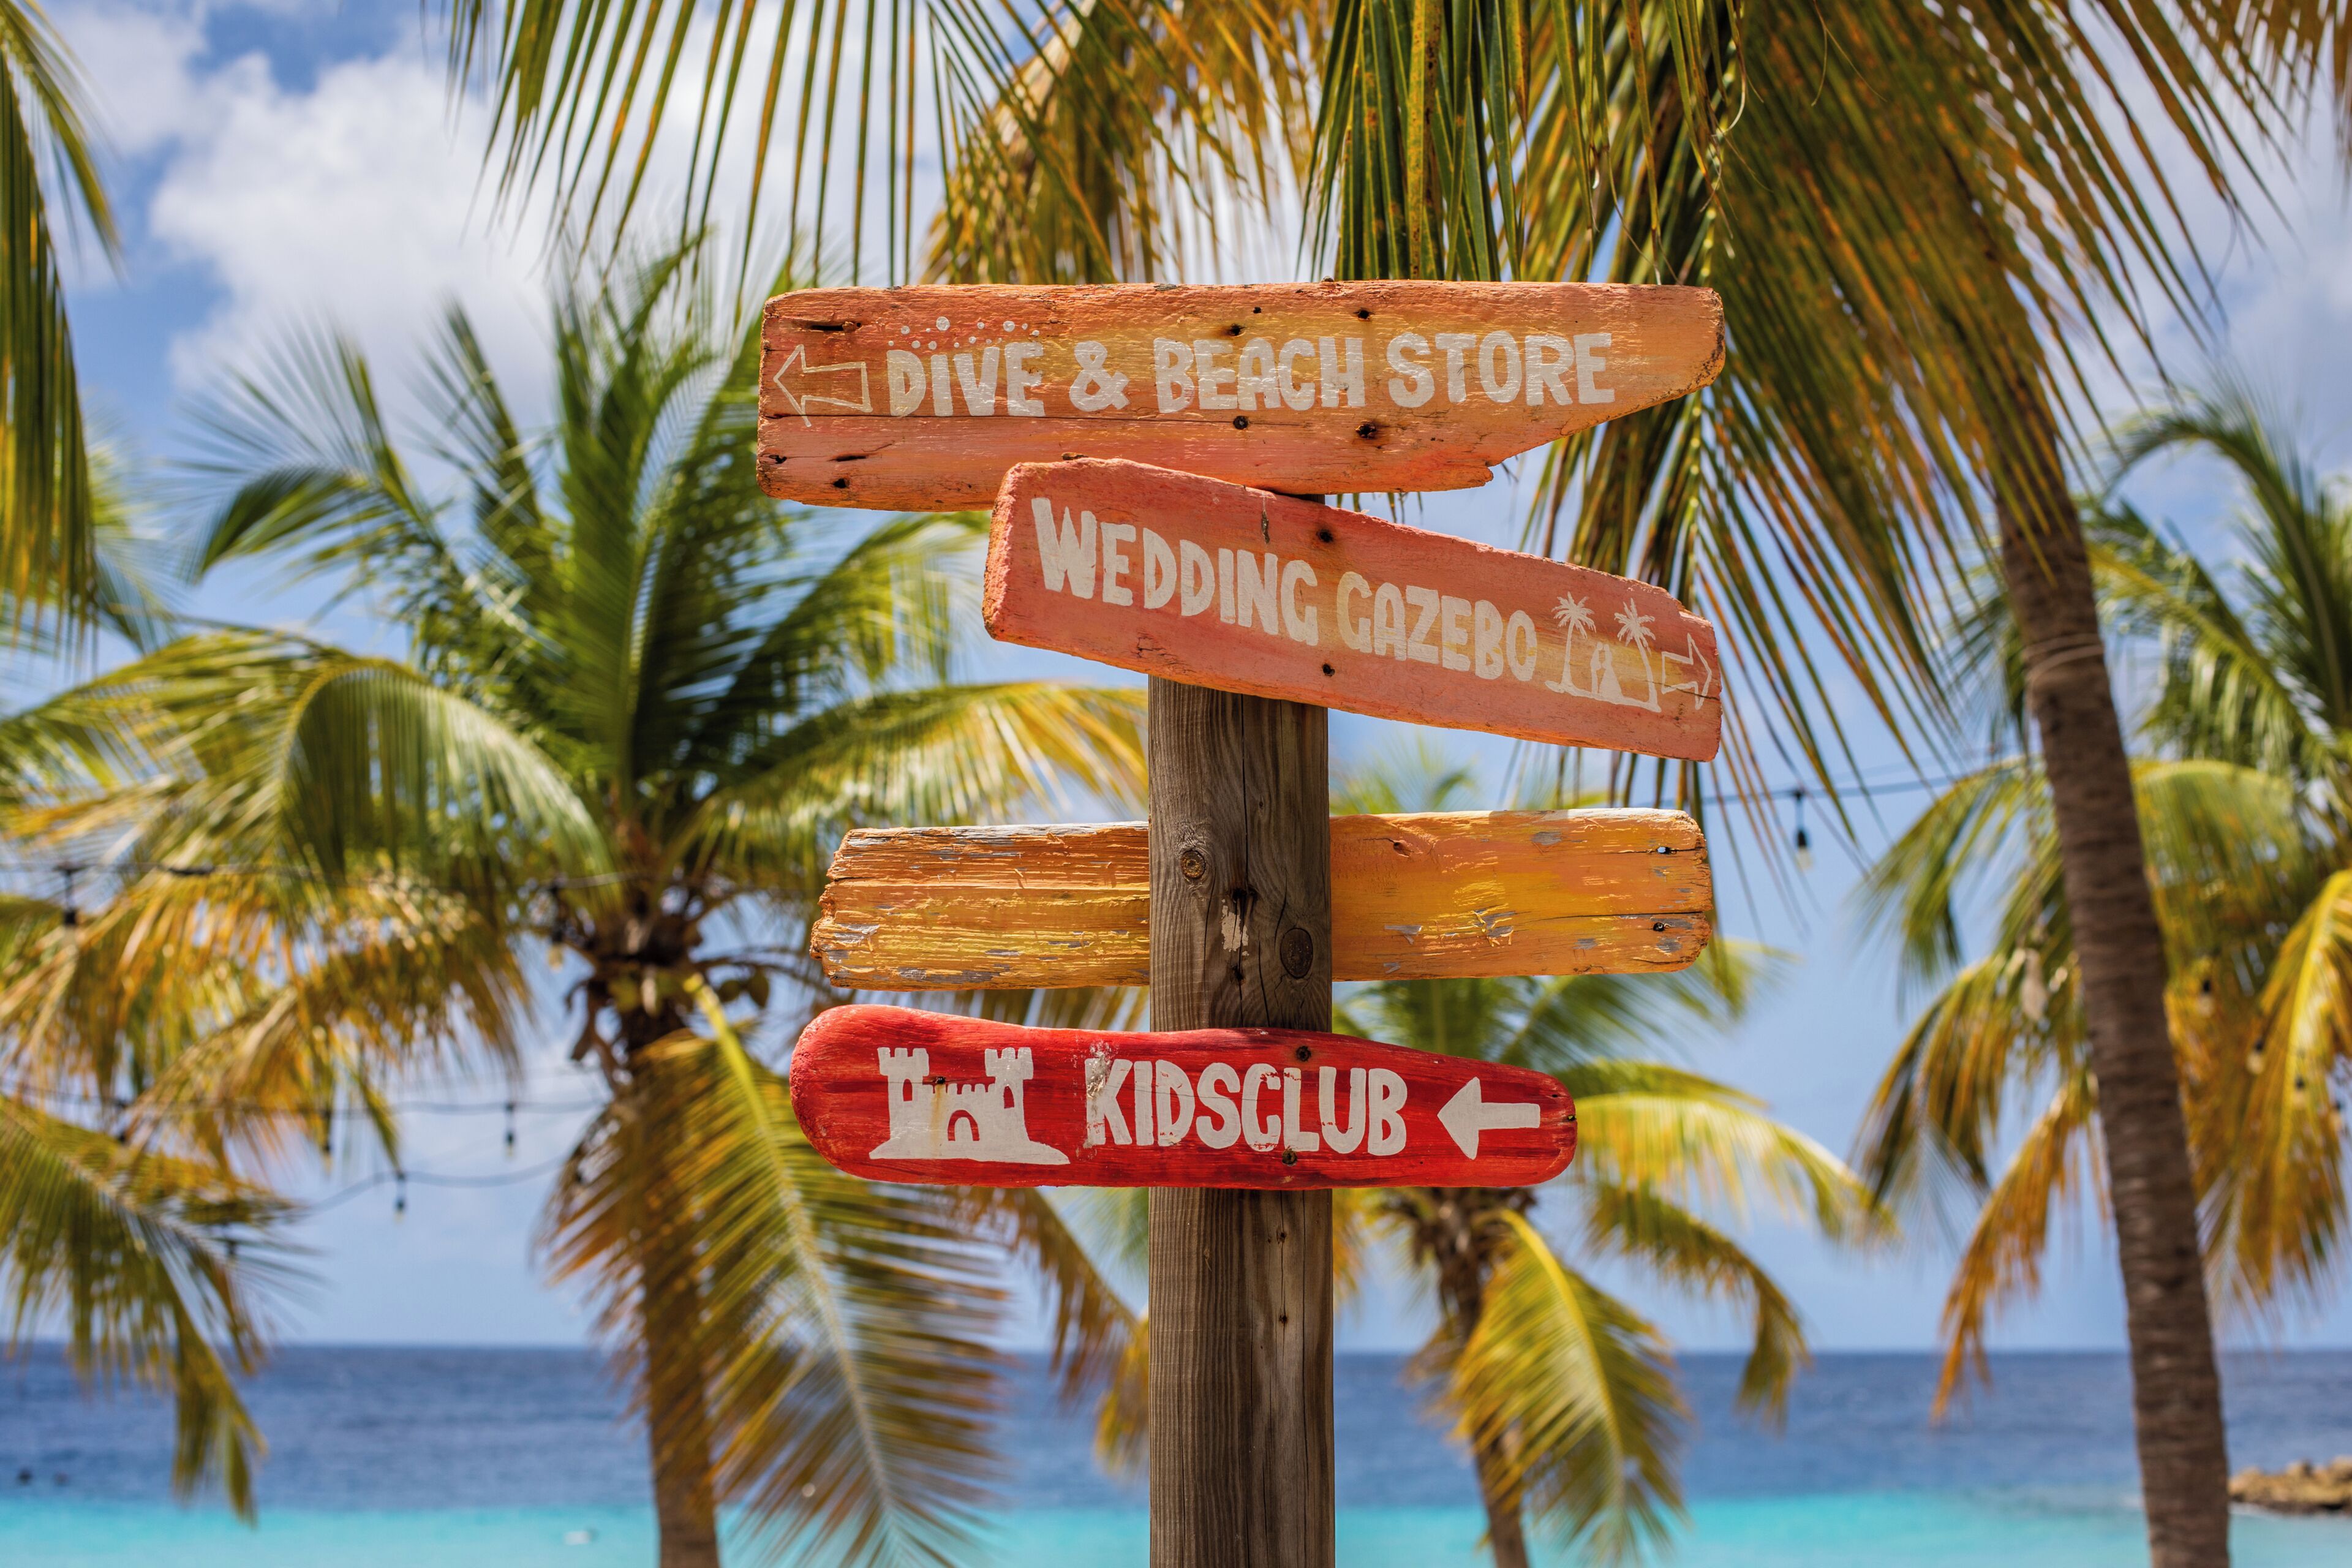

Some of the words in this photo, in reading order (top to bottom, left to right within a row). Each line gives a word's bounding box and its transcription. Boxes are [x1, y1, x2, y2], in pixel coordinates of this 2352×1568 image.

[886, 342, 1045, 417] DIVE
[1069, 340, 1129, 412] &
[1153, 336, 1365, 413] BEACH
[1387, 330, 1615, 408] STORE
[1031, 497, 1318, 646] WEDDING
[1336, 571, 1537, 681] GAZEBO
[1085, 1058, 1408, 1156] KIDSCLUB
